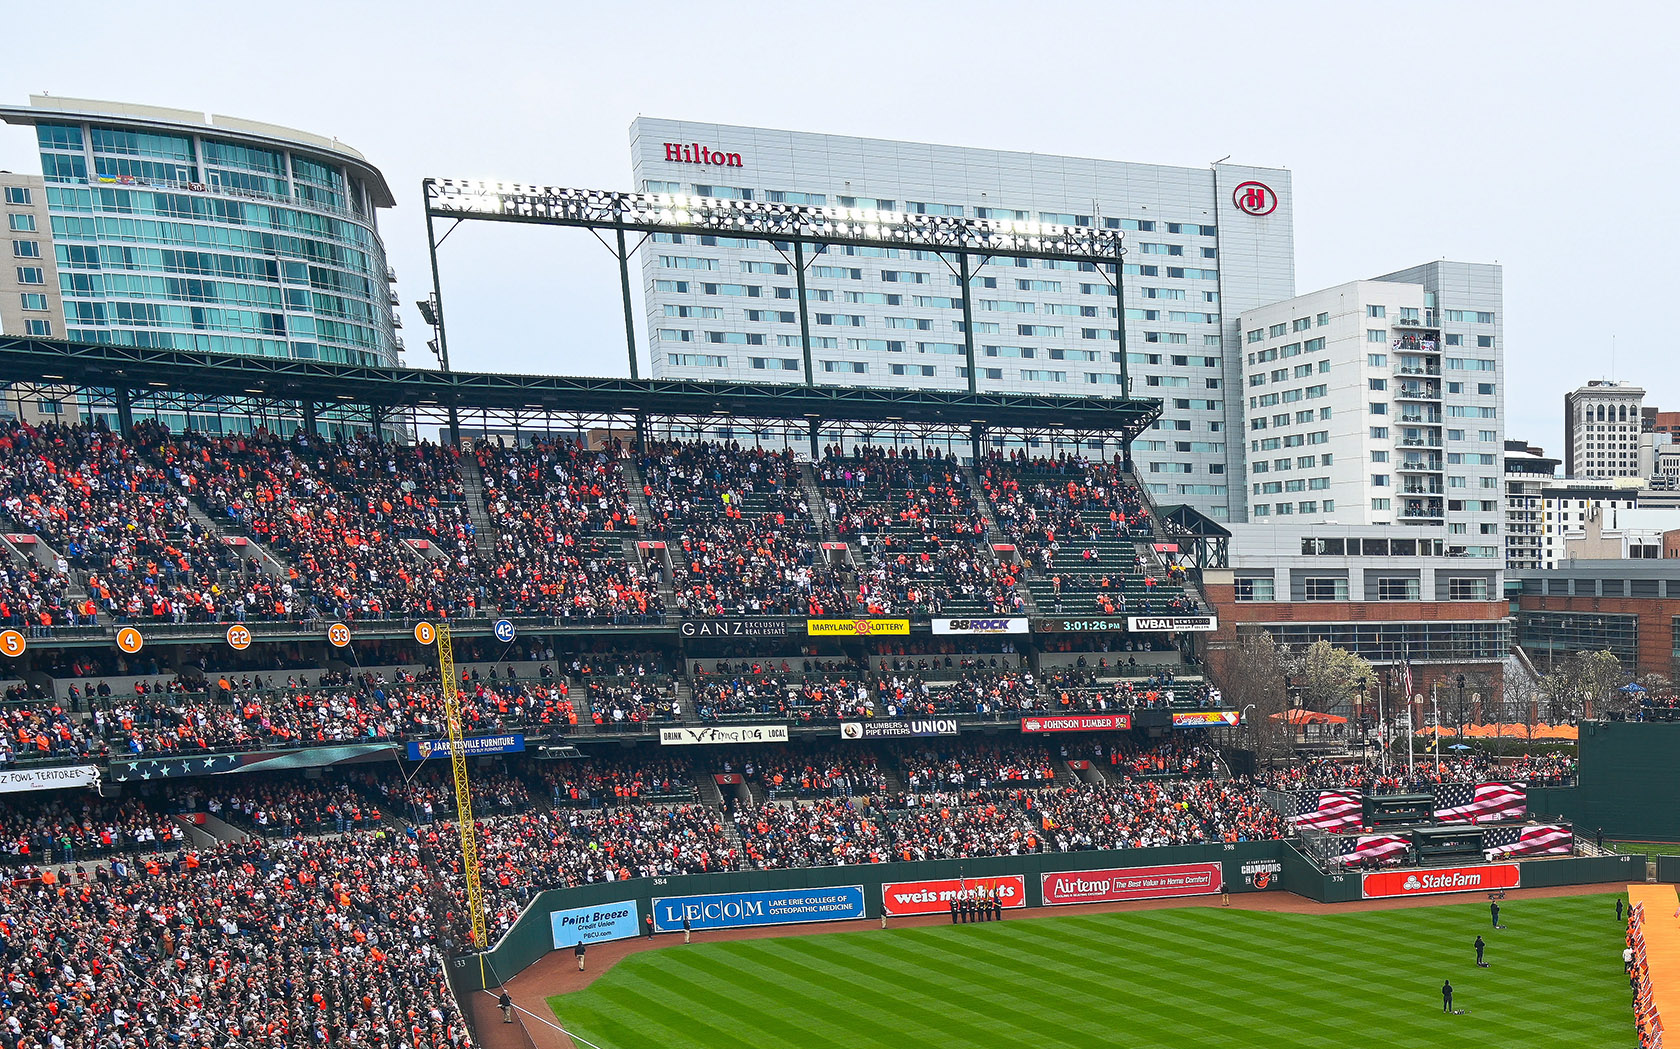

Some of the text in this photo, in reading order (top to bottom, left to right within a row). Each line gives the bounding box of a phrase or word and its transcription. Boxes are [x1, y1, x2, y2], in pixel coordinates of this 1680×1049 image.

[663, 142, 744, 167] Hilton
[681, 622, 743, 636] GANZ
[812, 623, 904, 631] MARYLAND LOTTERY
[1063, 620, 1107, 631] 3:01:26
[1137, 619, 1173, 629] WBAL
[332, 628, 348, 642] 33
[420, 626, 430, 640] 8
[497, 624, 512, 637] 42
[763, 627, 786, 635] ESTATE
[6, 635, 18, 651] 5
[124, 632, 135, 648] 4
[230, 630, 249, 645] 22
[865, 722, 902, 730] PLUMBERS
[911, 720, 957, 733] UNION
[1043, 719, 1079, 730] JOHNSON
[1082, 718, 1112, 729] LUMBER
[663, 732, 683, 740] DRINK
[768, 729, 786, 738] LOCAL
[883, 728, 911, 736] FITTERS
[480, 736, 515, 748] FURNITURE
[10, 772, 34, 783] FOWL
[1241, 863, 1282, 874] CHAMPIONS
[653, 878, 668, 886] 384
[1054, 878, 1110, 896] Airtemp
[1115, 880, 1127, 889] The
[1127, 879, 1142, 888] Best
[1142, 878, 1159, 887] Value
[1166, 876, 1184, 885] Home
[1185, 874, 1209, 883] Comfort
[768, 899, 788, 907] LAKE
[788, 898, 804, 906] ERIE
[804, 897, 836, 905] COLLEGE
[894, 888, 938, 904] weis
[592, 909, 629, 922] Breeze
[769, 903, 854, 916] OSTEOPATHIC MEDICINE
[577, 920, 616, 931] Credit Union
[583, 930, 612, 939] PBCU.com
